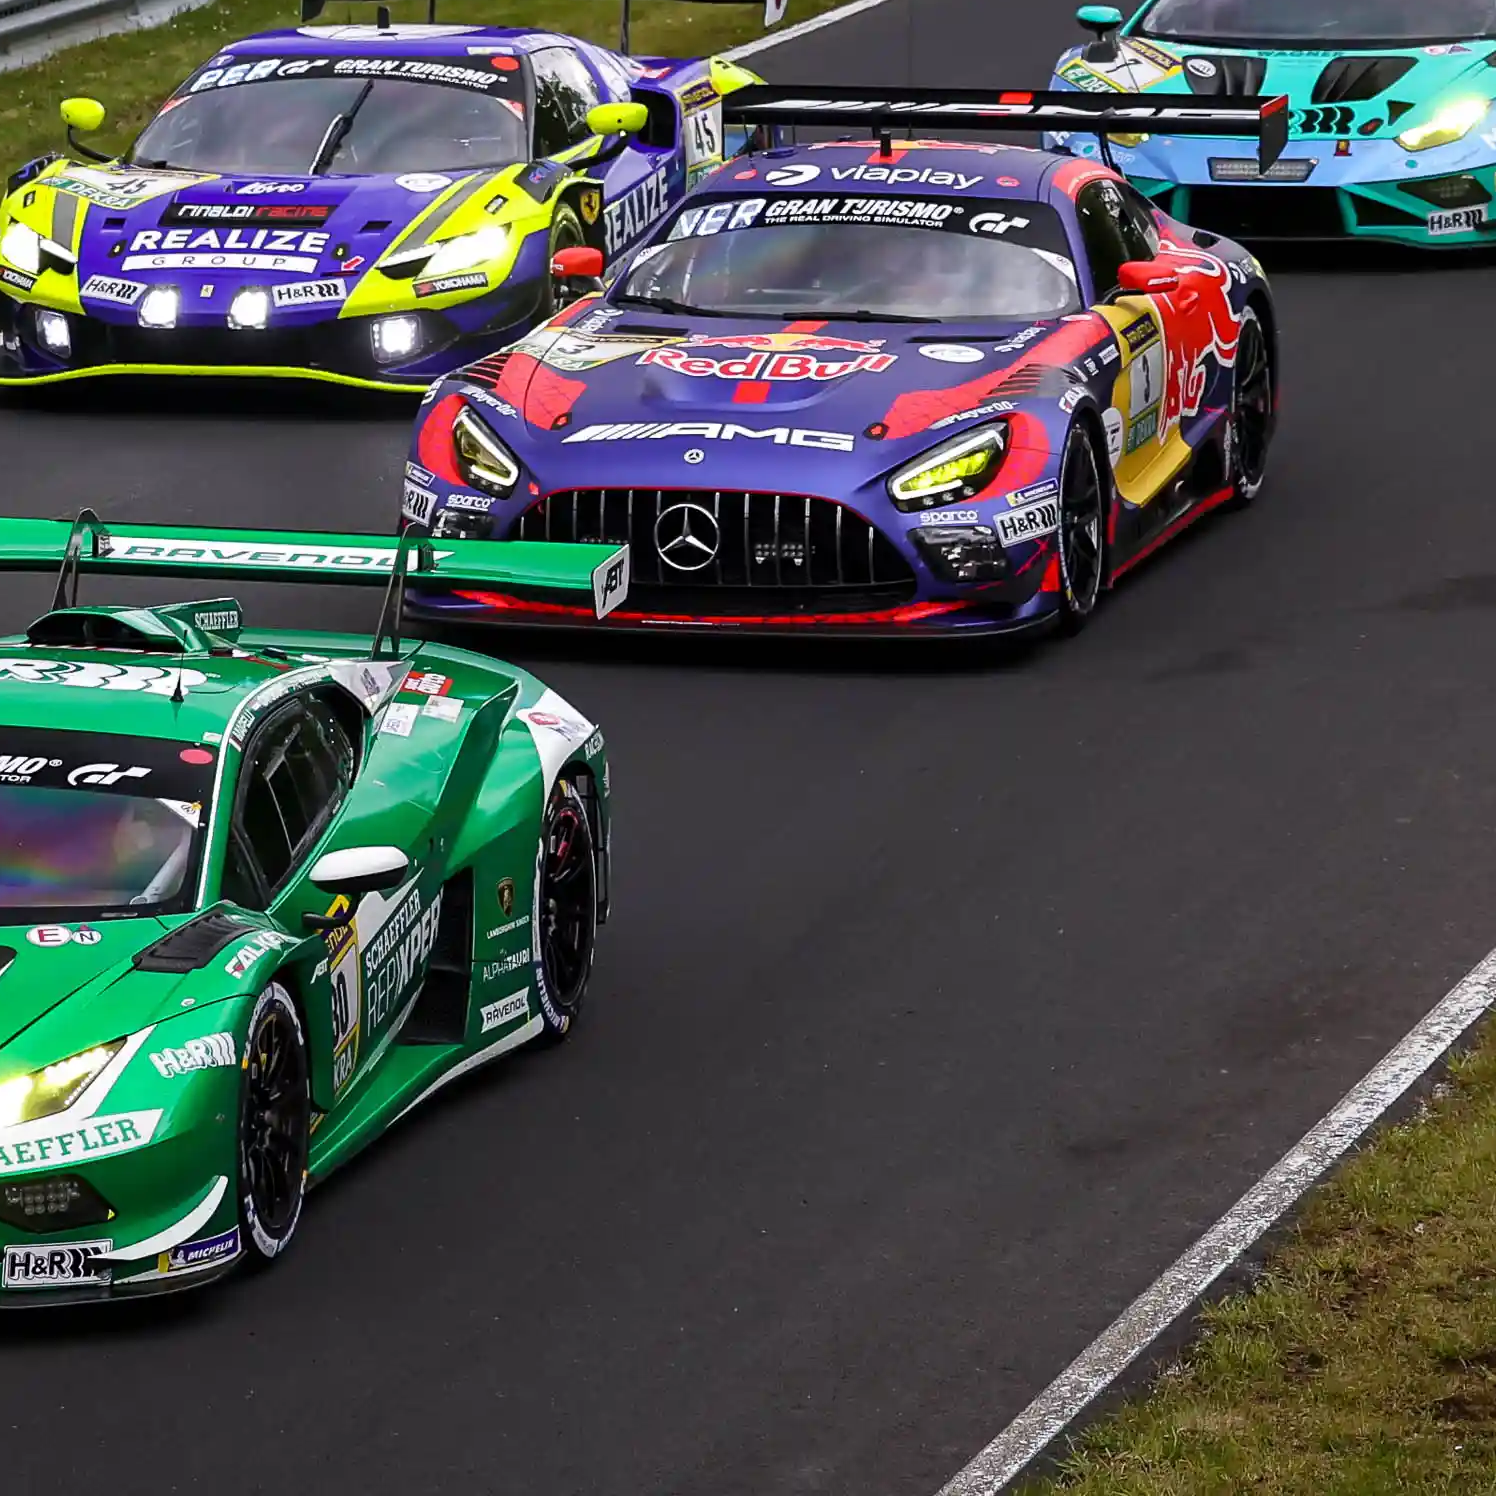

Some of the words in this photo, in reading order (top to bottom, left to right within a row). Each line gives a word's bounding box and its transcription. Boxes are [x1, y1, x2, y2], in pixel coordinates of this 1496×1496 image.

[334, 60, 400, 71] GRAN
[400, 60, 498, 86] TURISMO
[693, 112, 716, 159] 45
[107, 177, 147, 196] 45
[829, 161, 984, 191] viaplay
[70, 182, 129, 208] DEKRA
[603, 167, 669, 255] REALIZE
[764, 215, 787, 224] THE
[789, 215, 820, 223] REAL
[822, 215, 871, 223] DRIVING
[873, 217, 944, 228] SIMULATOR
[765, 198, 839, 218] GRAN
[839, 198, 953, 221] TURISMO
[1430, 214, 1463, 232] H&R
[129, 228, 332, 254] REALIZE
[151, 255, 288, 268] GROUP
[85, 277, 119, 297] H&R
[277, 284, 317, 301] H&R
[432, 274, 487, 292] YOKOHAMA
[635, 347, 769, 380] Red
[763, 350, 899, 382] Bull
[1141, 355, 1153, 404] 3
[447, 493, 491, 510] sparco
[919, 510, 978, 524] sparco
[1002, 510, 1042, 539] H&R
[124, 545, 406, 568] RAVENOL
[601, 558, 625, 610] ABT
[194, 610, 240, 631] SCHAEFFLER
[364, 888, 421, 978] SCHAEFFLER
[481, 947, 530, 983] ALPHATAURI
[331, 970, 352, 1047] 30
[484, 995, 526, 1024] RAVENOL
[148, 1039, 210, 1080] H&R
[332, 1047, 352, 1092] KRA
[186, 1236, 236, 1263] MICHELIN
[8, 1250, 72, 1281] H&R
